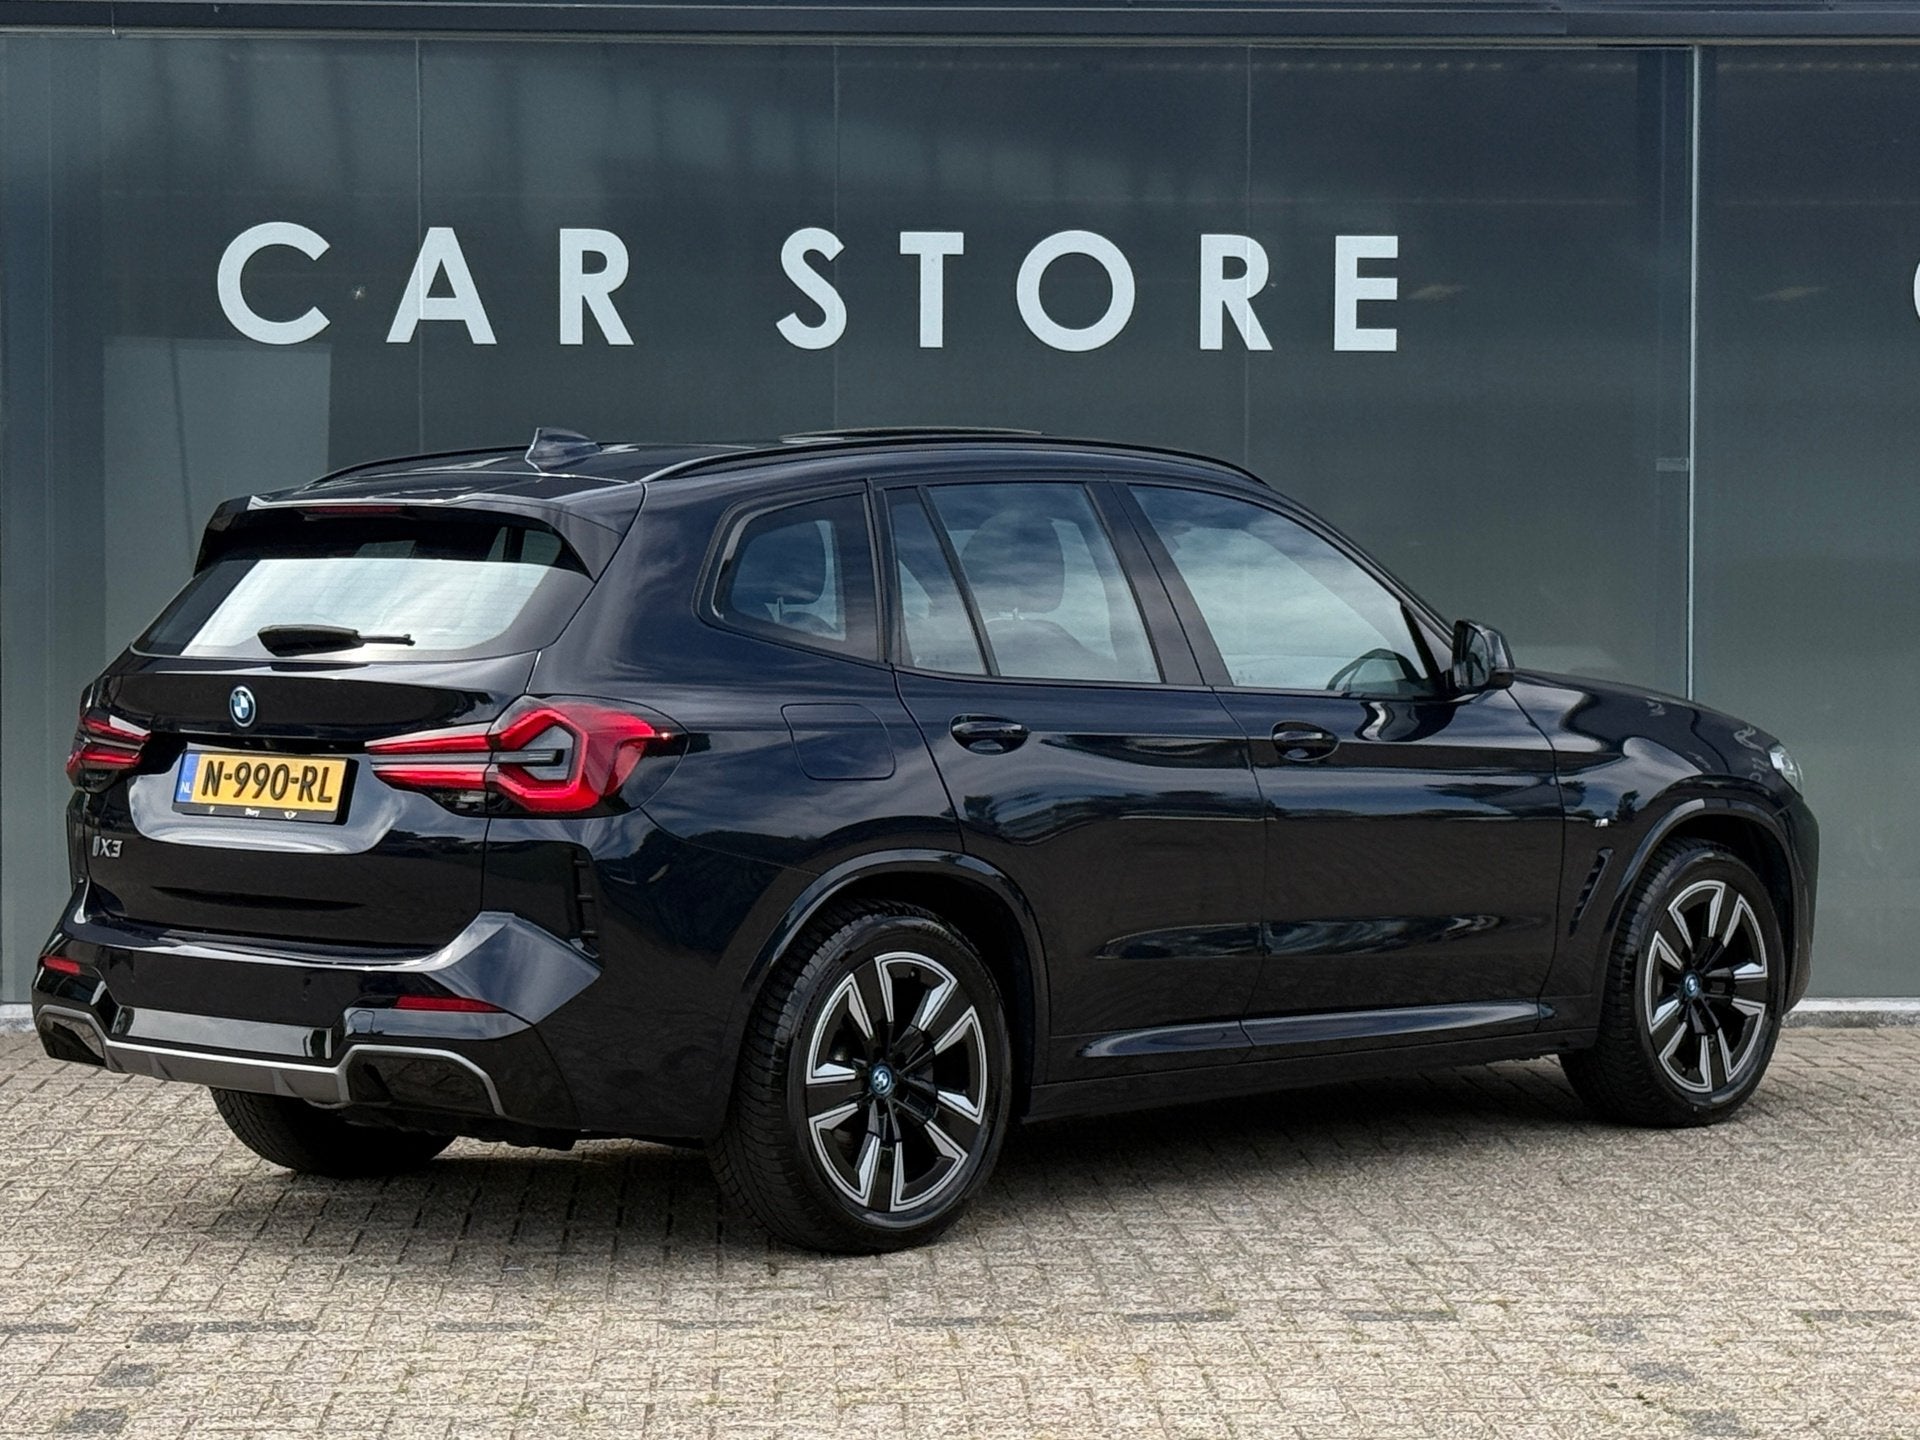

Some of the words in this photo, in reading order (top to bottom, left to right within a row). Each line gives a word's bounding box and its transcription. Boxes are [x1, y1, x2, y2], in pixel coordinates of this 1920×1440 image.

[217, 221, 634, 346] CAR
[776, 227, 1398, 353] STORE
[180, 781, 192, 794] NL
[201, 760, 333, 804] N-990-RL
